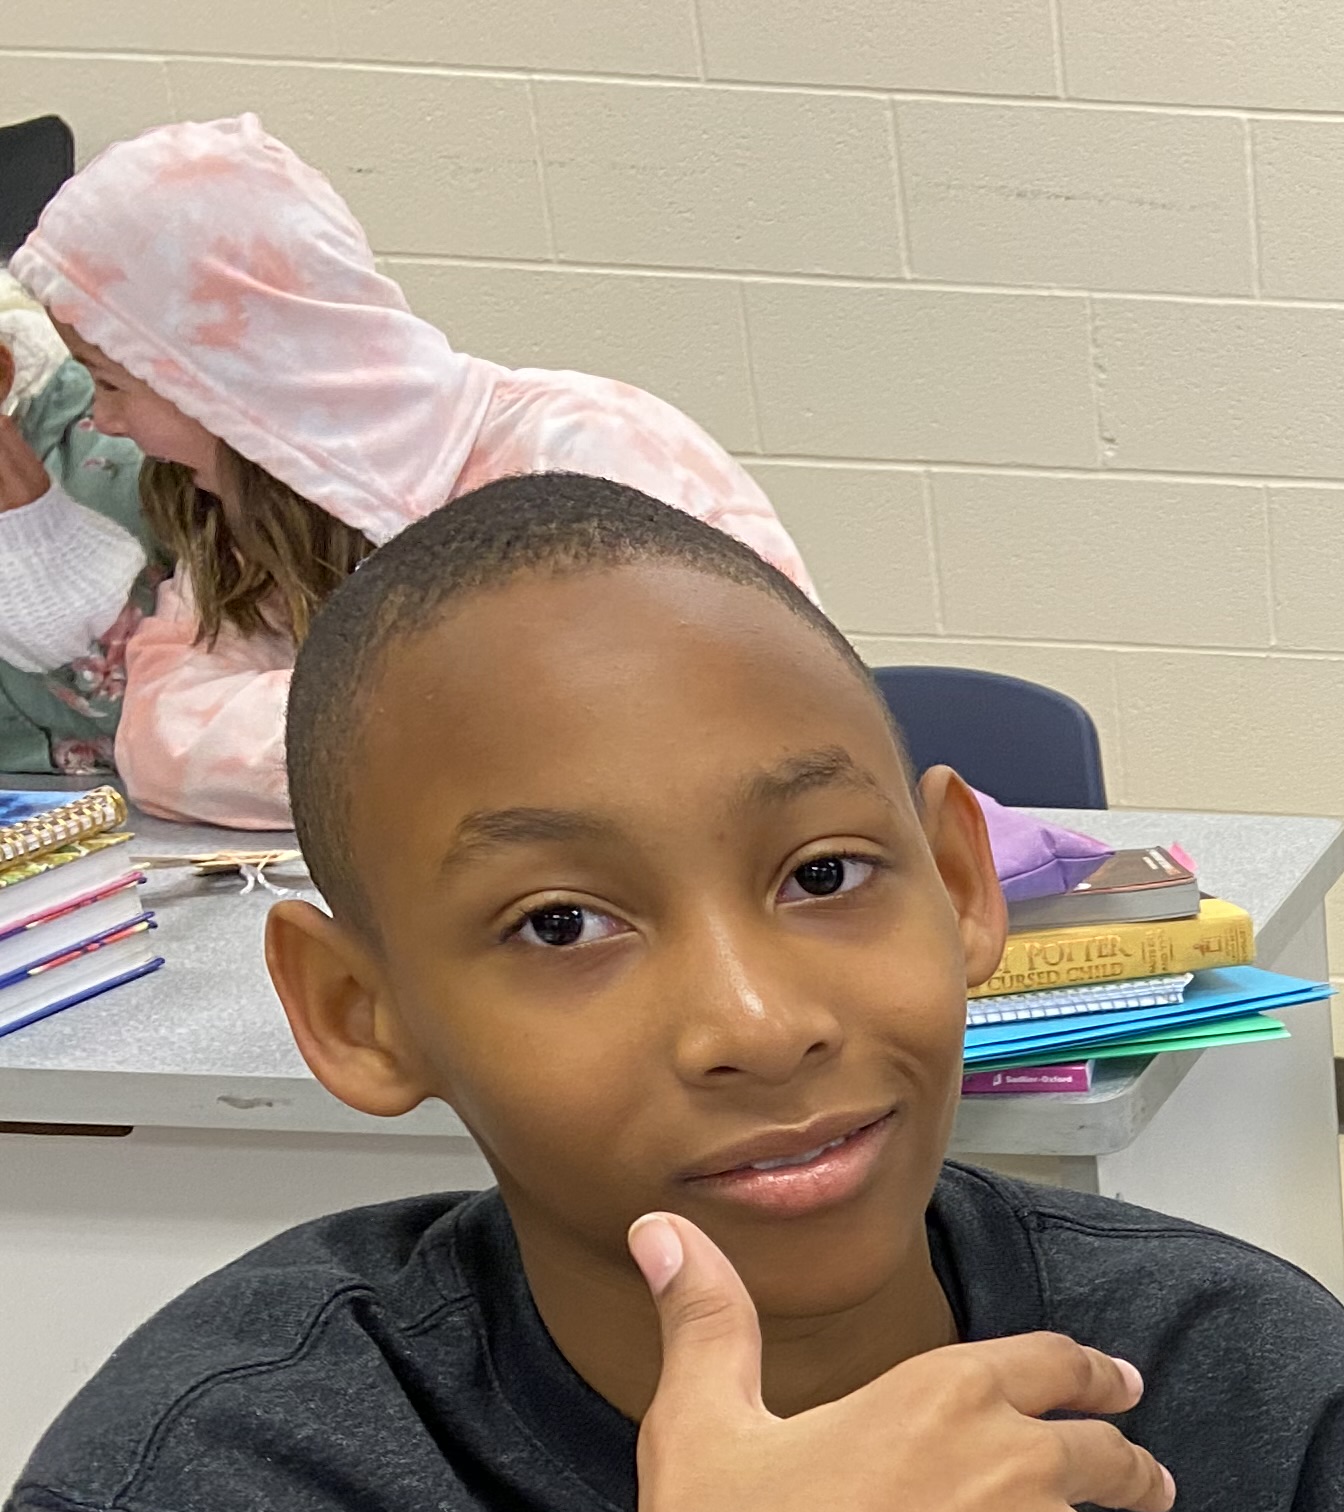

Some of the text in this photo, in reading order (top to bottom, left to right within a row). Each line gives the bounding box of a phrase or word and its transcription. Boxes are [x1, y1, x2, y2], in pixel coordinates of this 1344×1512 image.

[1024, 934, 1132, 971] POTTER
[987, 962, 1124, 991] CURSED CHILD
[1006, 1074, 1073, 1084] Sadlier-Oxford
